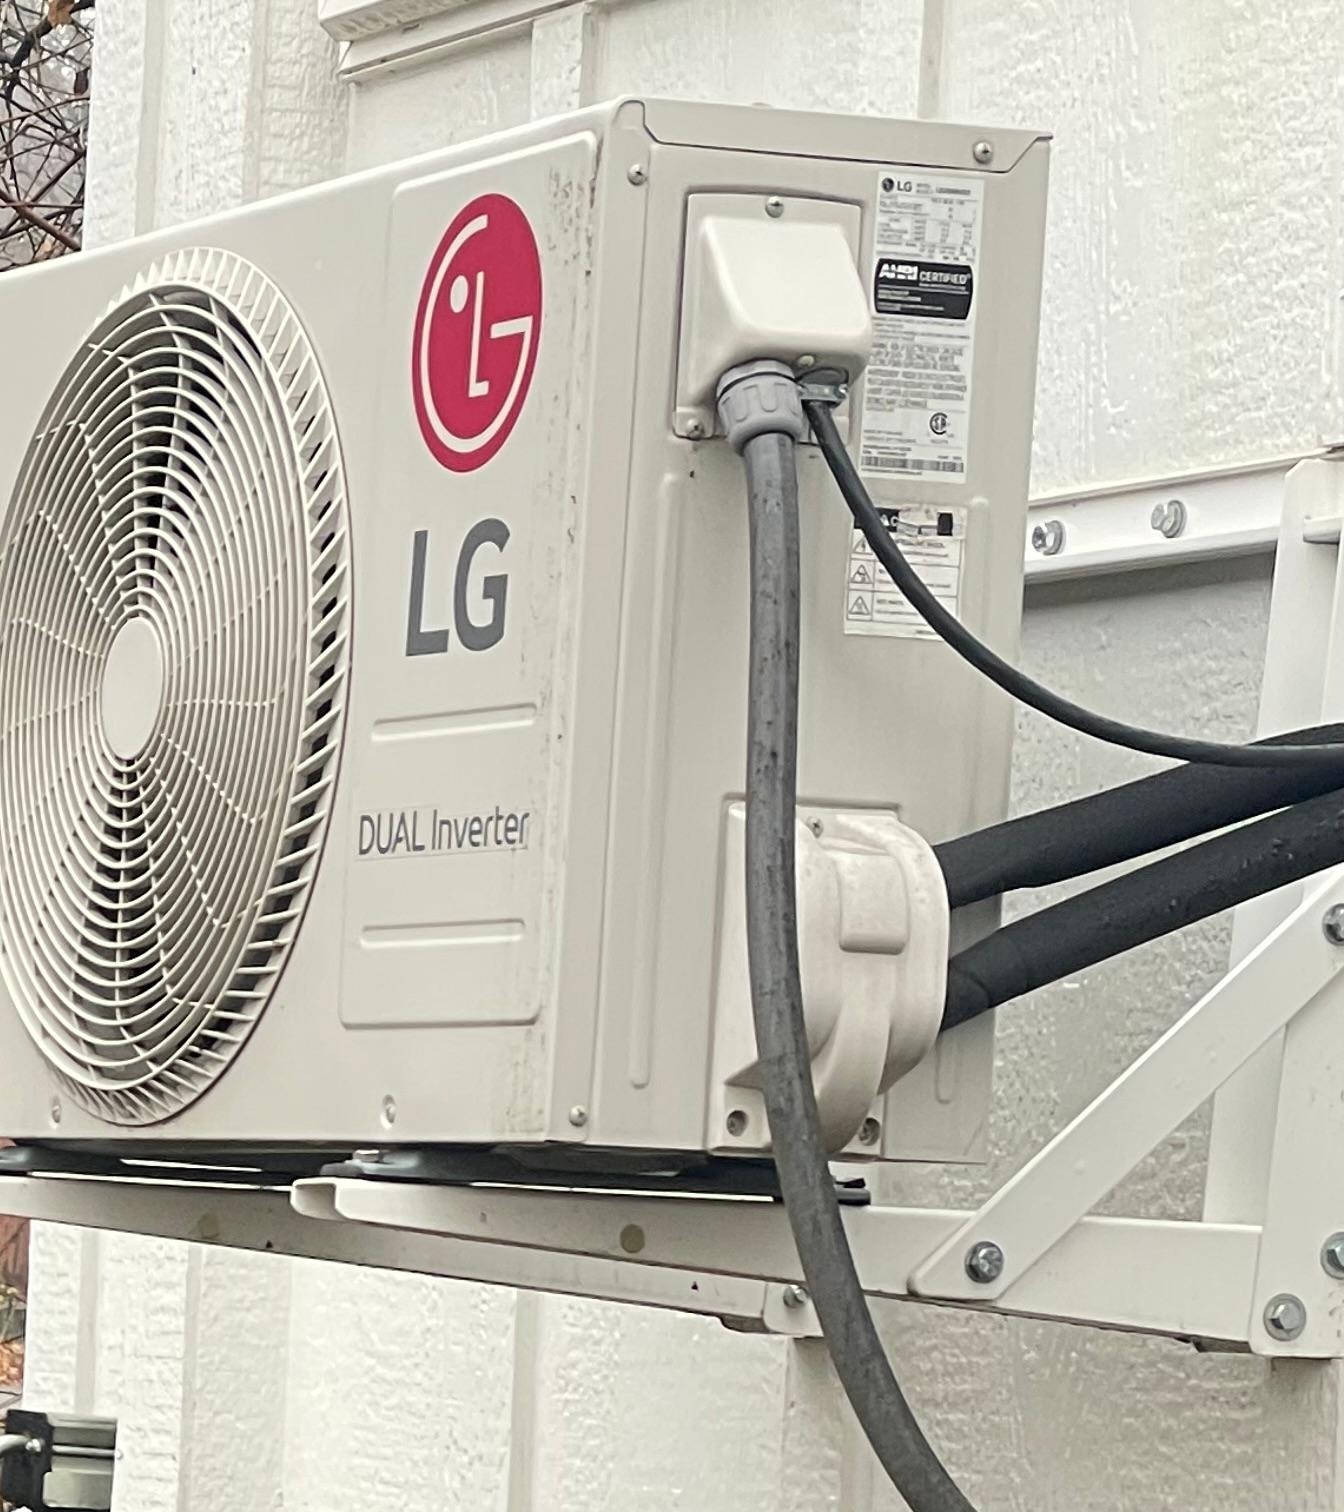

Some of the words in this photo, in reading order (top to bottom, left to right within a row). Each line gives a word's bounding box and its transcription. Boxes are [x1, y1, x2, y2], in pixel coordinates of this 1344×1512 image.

[897, 181, 912, 192] LG
[919, 271, 968, 284] CERTIFIED
[405, 517, 511, 657] LG
[358, 810, 425, 855] DUAL
[431, 805, 530, 850] Inverter
